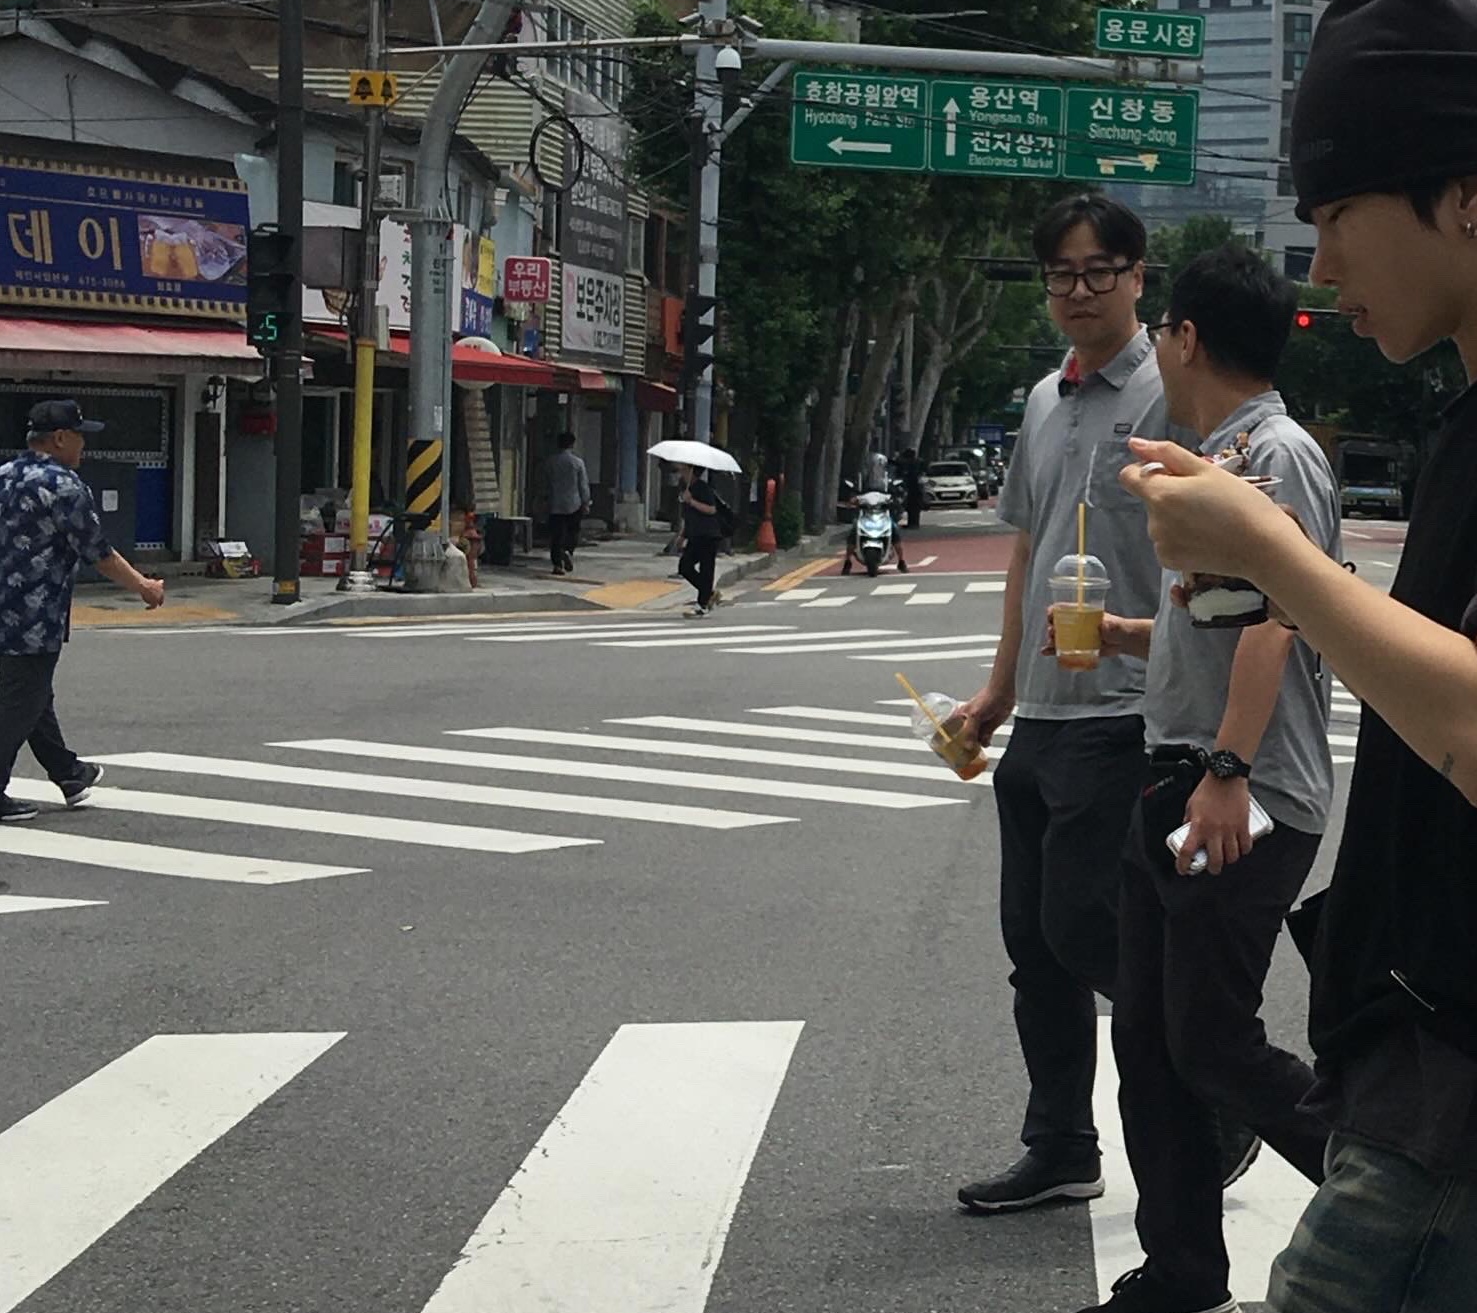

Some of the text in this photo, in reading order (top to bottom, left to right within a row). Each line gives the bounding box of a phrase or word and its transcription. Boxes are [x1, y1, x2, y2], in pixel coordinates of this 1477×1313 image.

[1104, 18, 1196, 48] 용문시장
[805, 81, 919, 109] 효창공원앞역
[968, 86, 1040, 111] 용산역
[805, 108, 857, 129] Hyochang
[969, 109, 1048, 126] Yongsan Stn
[1089, 96, 1176, 123] 신창동
[970, 131, 1055, 155] 전자상가
[1088, 122, 1178, 147] Sinchang-dong
[968, 154, 1054, 169] Electronics Market
[512, 263, 542, 279] 우리
[508, 279, 547, 300] 부동산
